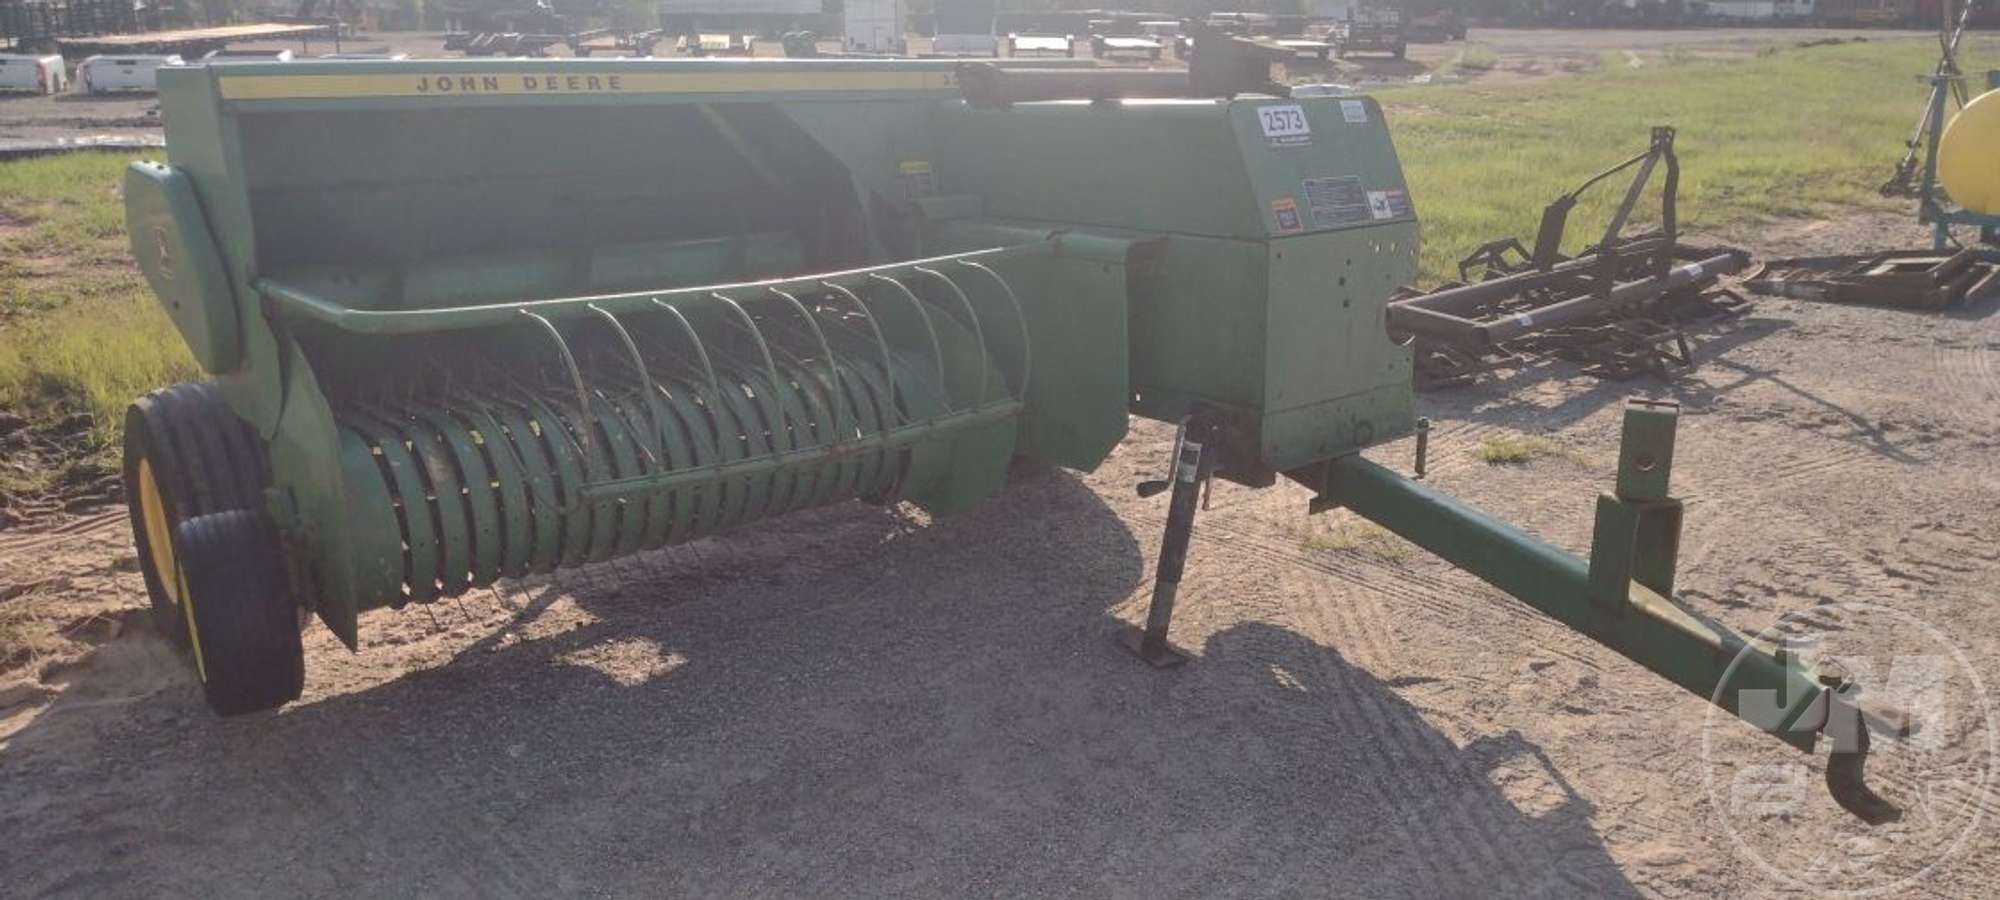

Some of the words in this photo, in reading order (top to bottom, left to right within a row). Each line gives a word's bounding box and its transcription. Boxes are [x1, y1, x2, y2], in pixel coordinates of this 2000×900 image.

[416, 76, 499, 92] JOHN
[522, 75, 624, 91] DEERE
[1263, 110, 1303, 131] 2573
